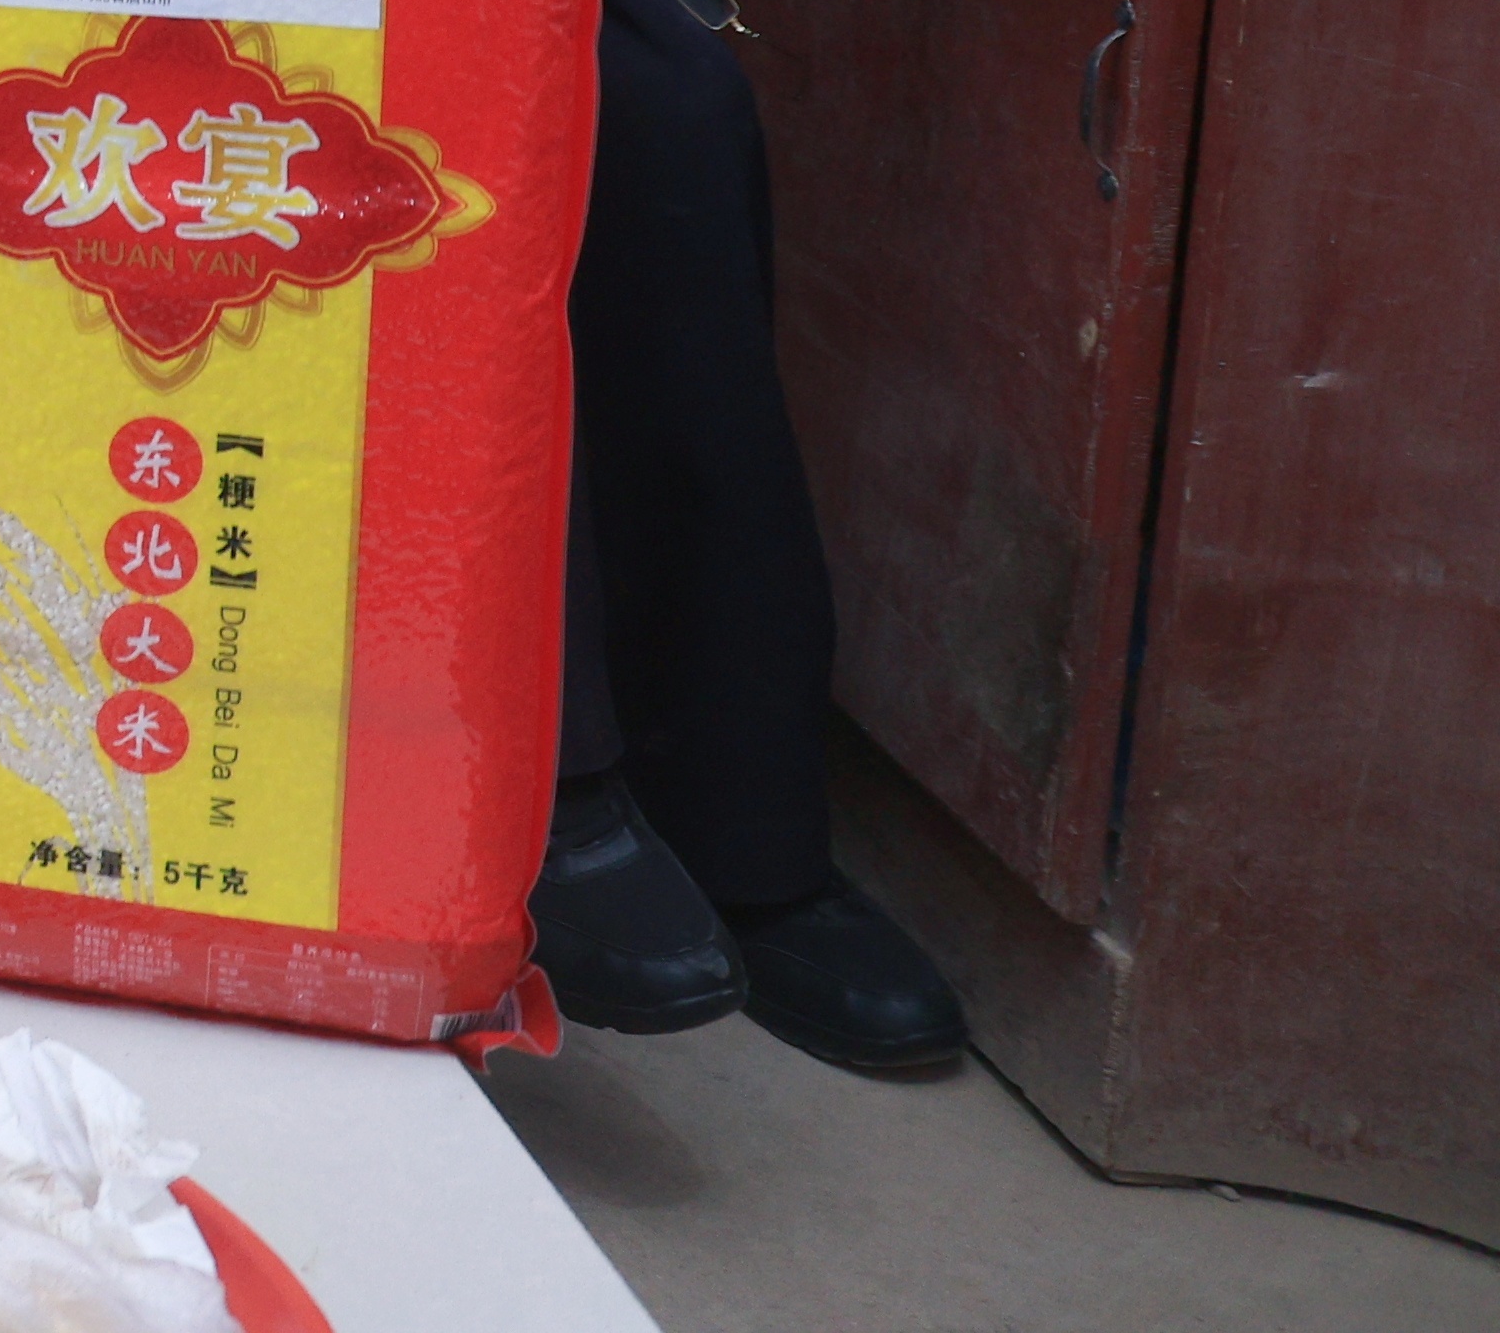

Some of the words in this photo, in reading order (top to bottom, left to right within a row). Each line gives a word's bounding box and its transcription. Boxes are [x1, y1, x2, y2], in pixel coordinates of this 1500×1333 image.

[22, 92, 322, 250] 欢宴
[76, 238, 176, 273] HUAN
[187, 247, 259, 281] YAN
[114, 429, 184, 759] 东北大米
[211, 604, 247, 674] Dong
[214, 687, 243, 729] Bei
[210, 743, 240, 781] Da
[209, 796, 235, 829] Mi
